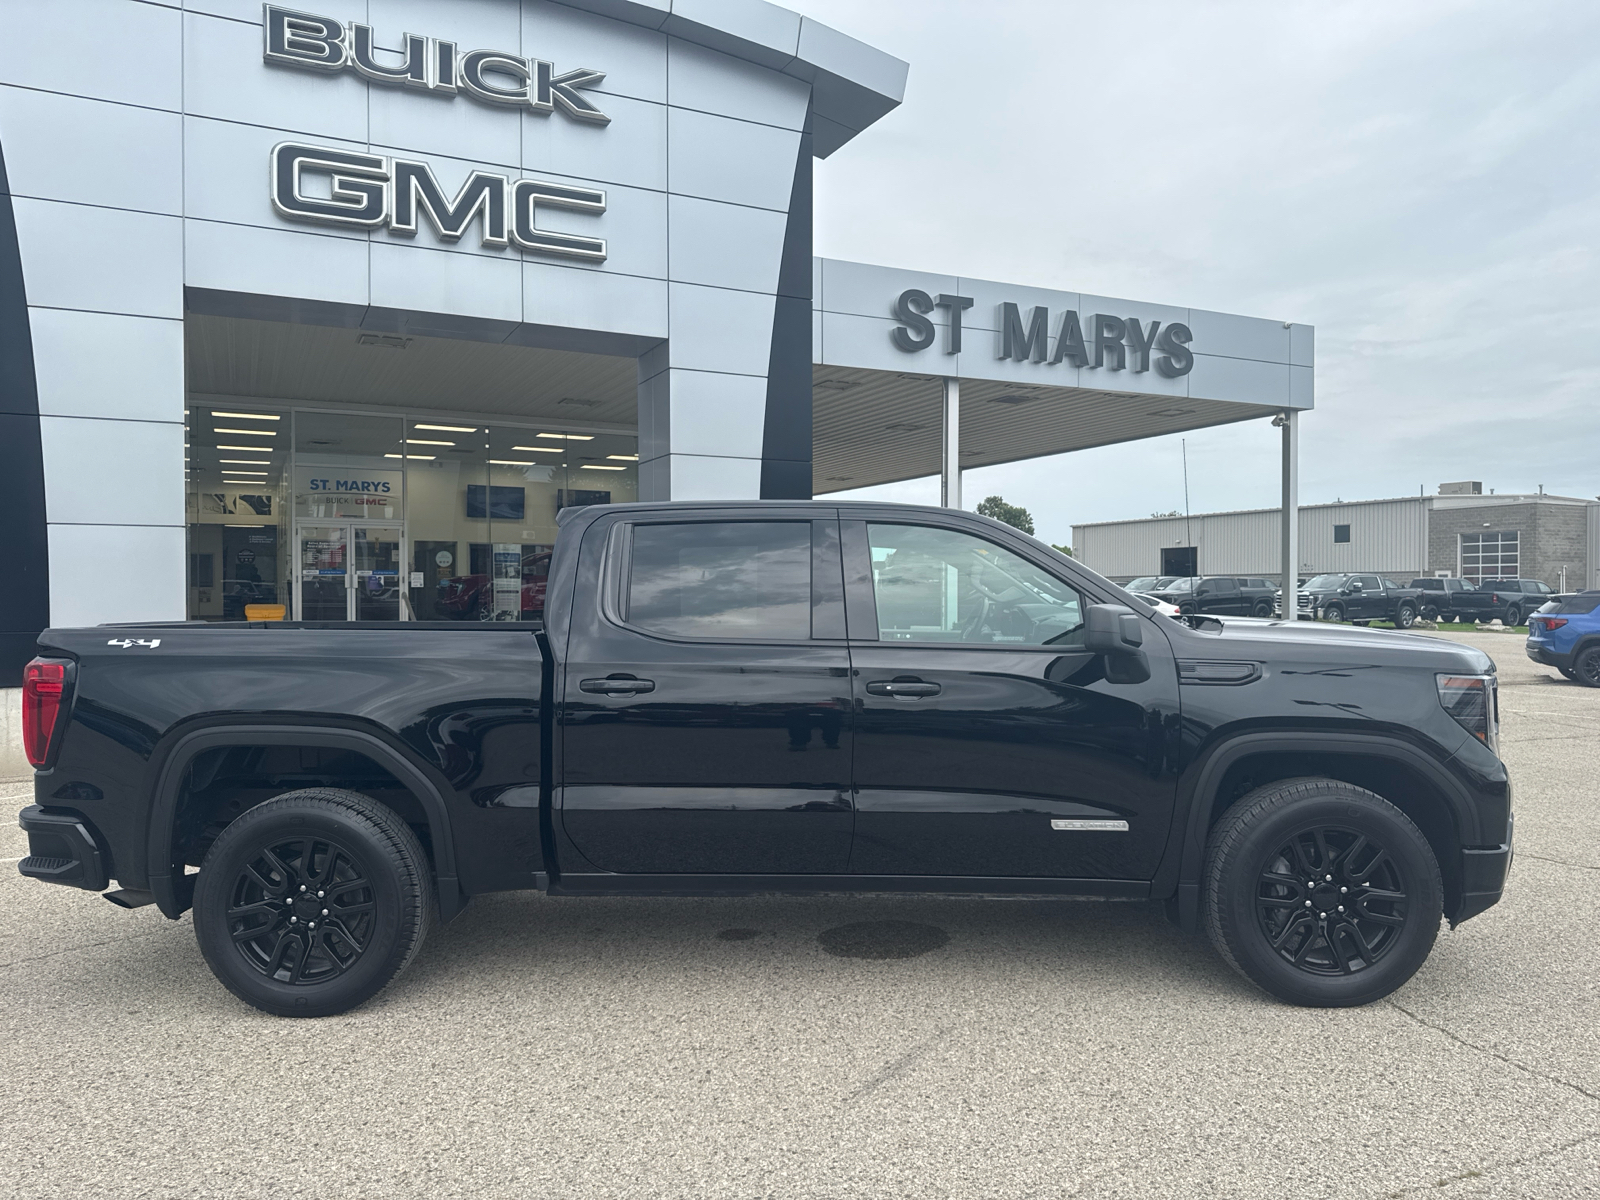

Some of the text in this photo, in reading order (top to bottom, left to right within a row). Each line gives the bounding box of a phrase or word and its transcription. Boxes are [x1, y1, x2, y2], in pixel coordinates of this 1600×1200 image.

[263, 2, 612, 127] BUICK
[270, 140, 608, 263] GMC
[892, 288, 1194, 378] ST MARYS
[310, 479, 391, 493] ST. MARYS
[326, 497, 388, 506] BUICK GMC
[1056, 821, 1124, 829] ELEVATION
